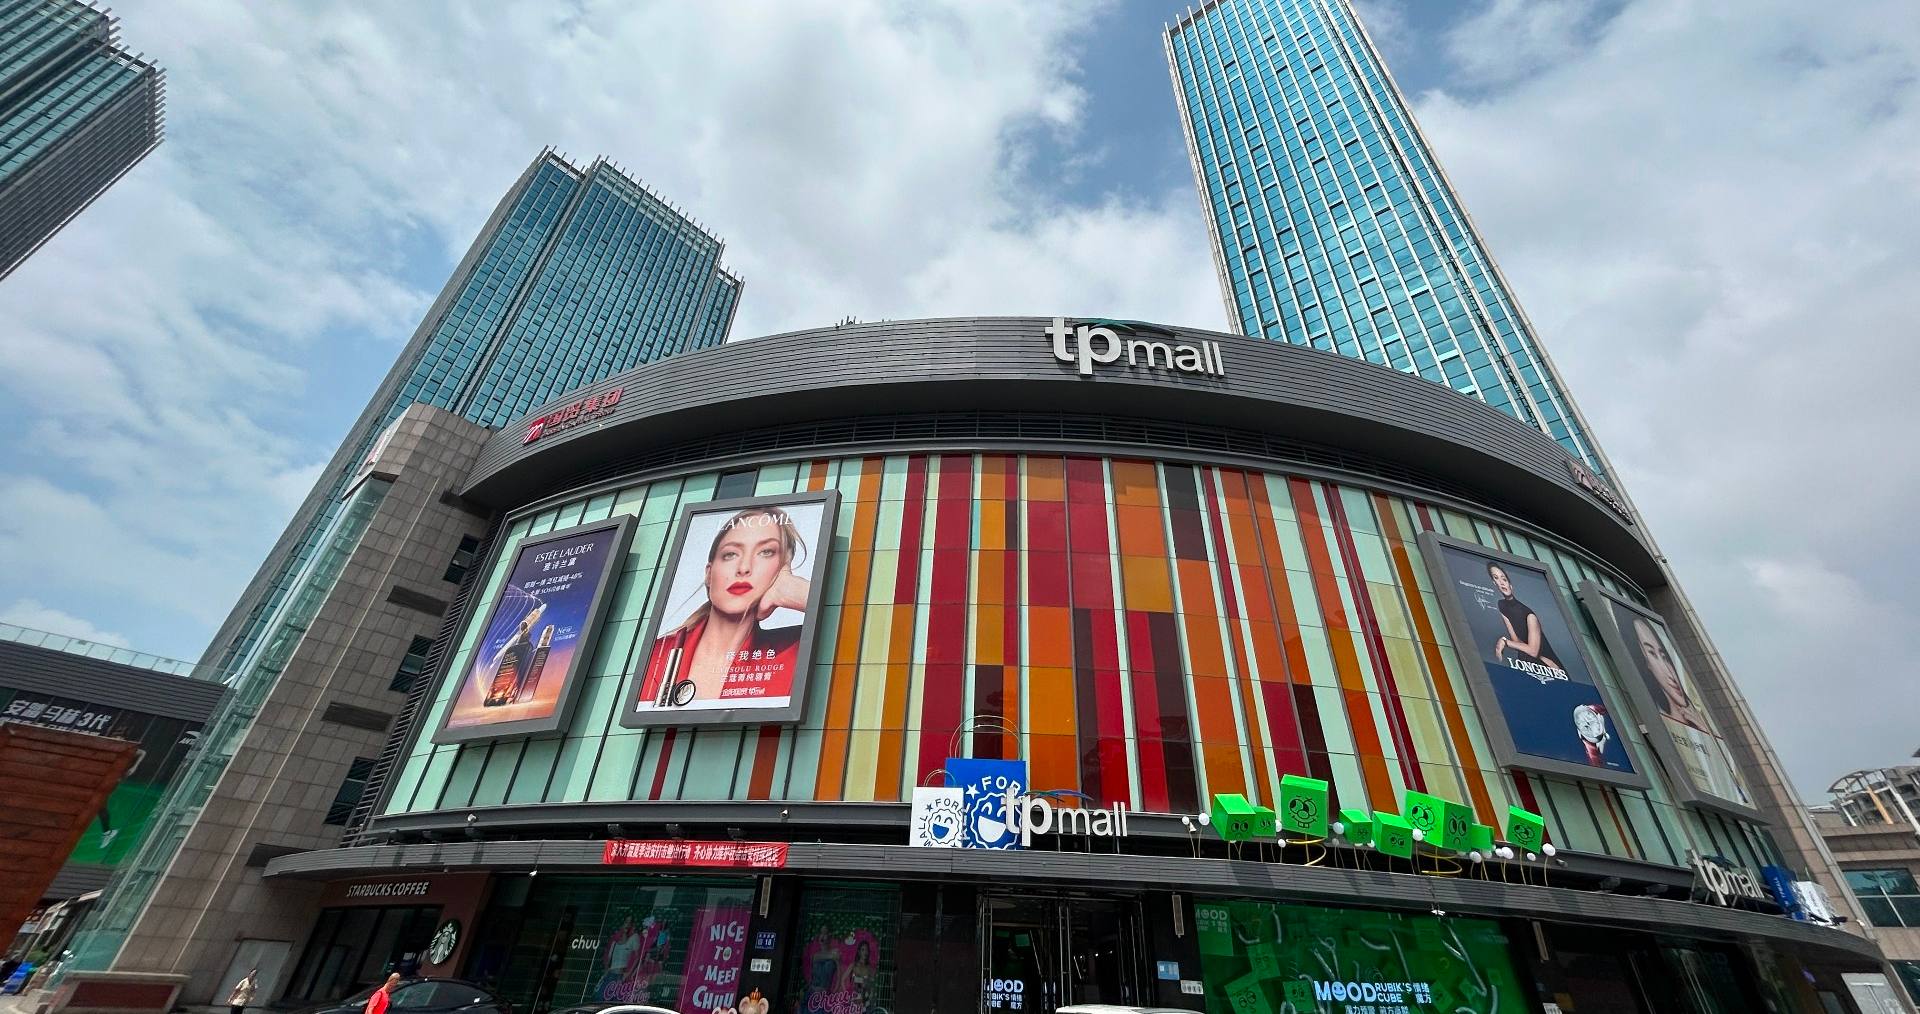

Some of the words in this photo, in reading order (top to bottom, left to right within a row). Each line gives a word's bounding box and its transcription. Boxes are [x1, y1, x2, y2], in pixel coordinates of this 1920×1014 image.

[559, 543, 594, 558] LAUDER
[1507, 657, 1568, 681] LONGINES
[346, 883, 391, 898] STARBUCKS
[392, 881, 430, 896] COFFEE
[710, 920, 744, 942] NICE
[571, 935, 600, 950] chuu
[714, 945, 732, 961] TO
[704, 965, 739, 985] MEET
[1313, 980, 1377, 1002] MOOD
[1374, 982, 1412, 993] RUBIK'S
[1377, 993, 1403, 1003] CUBE
